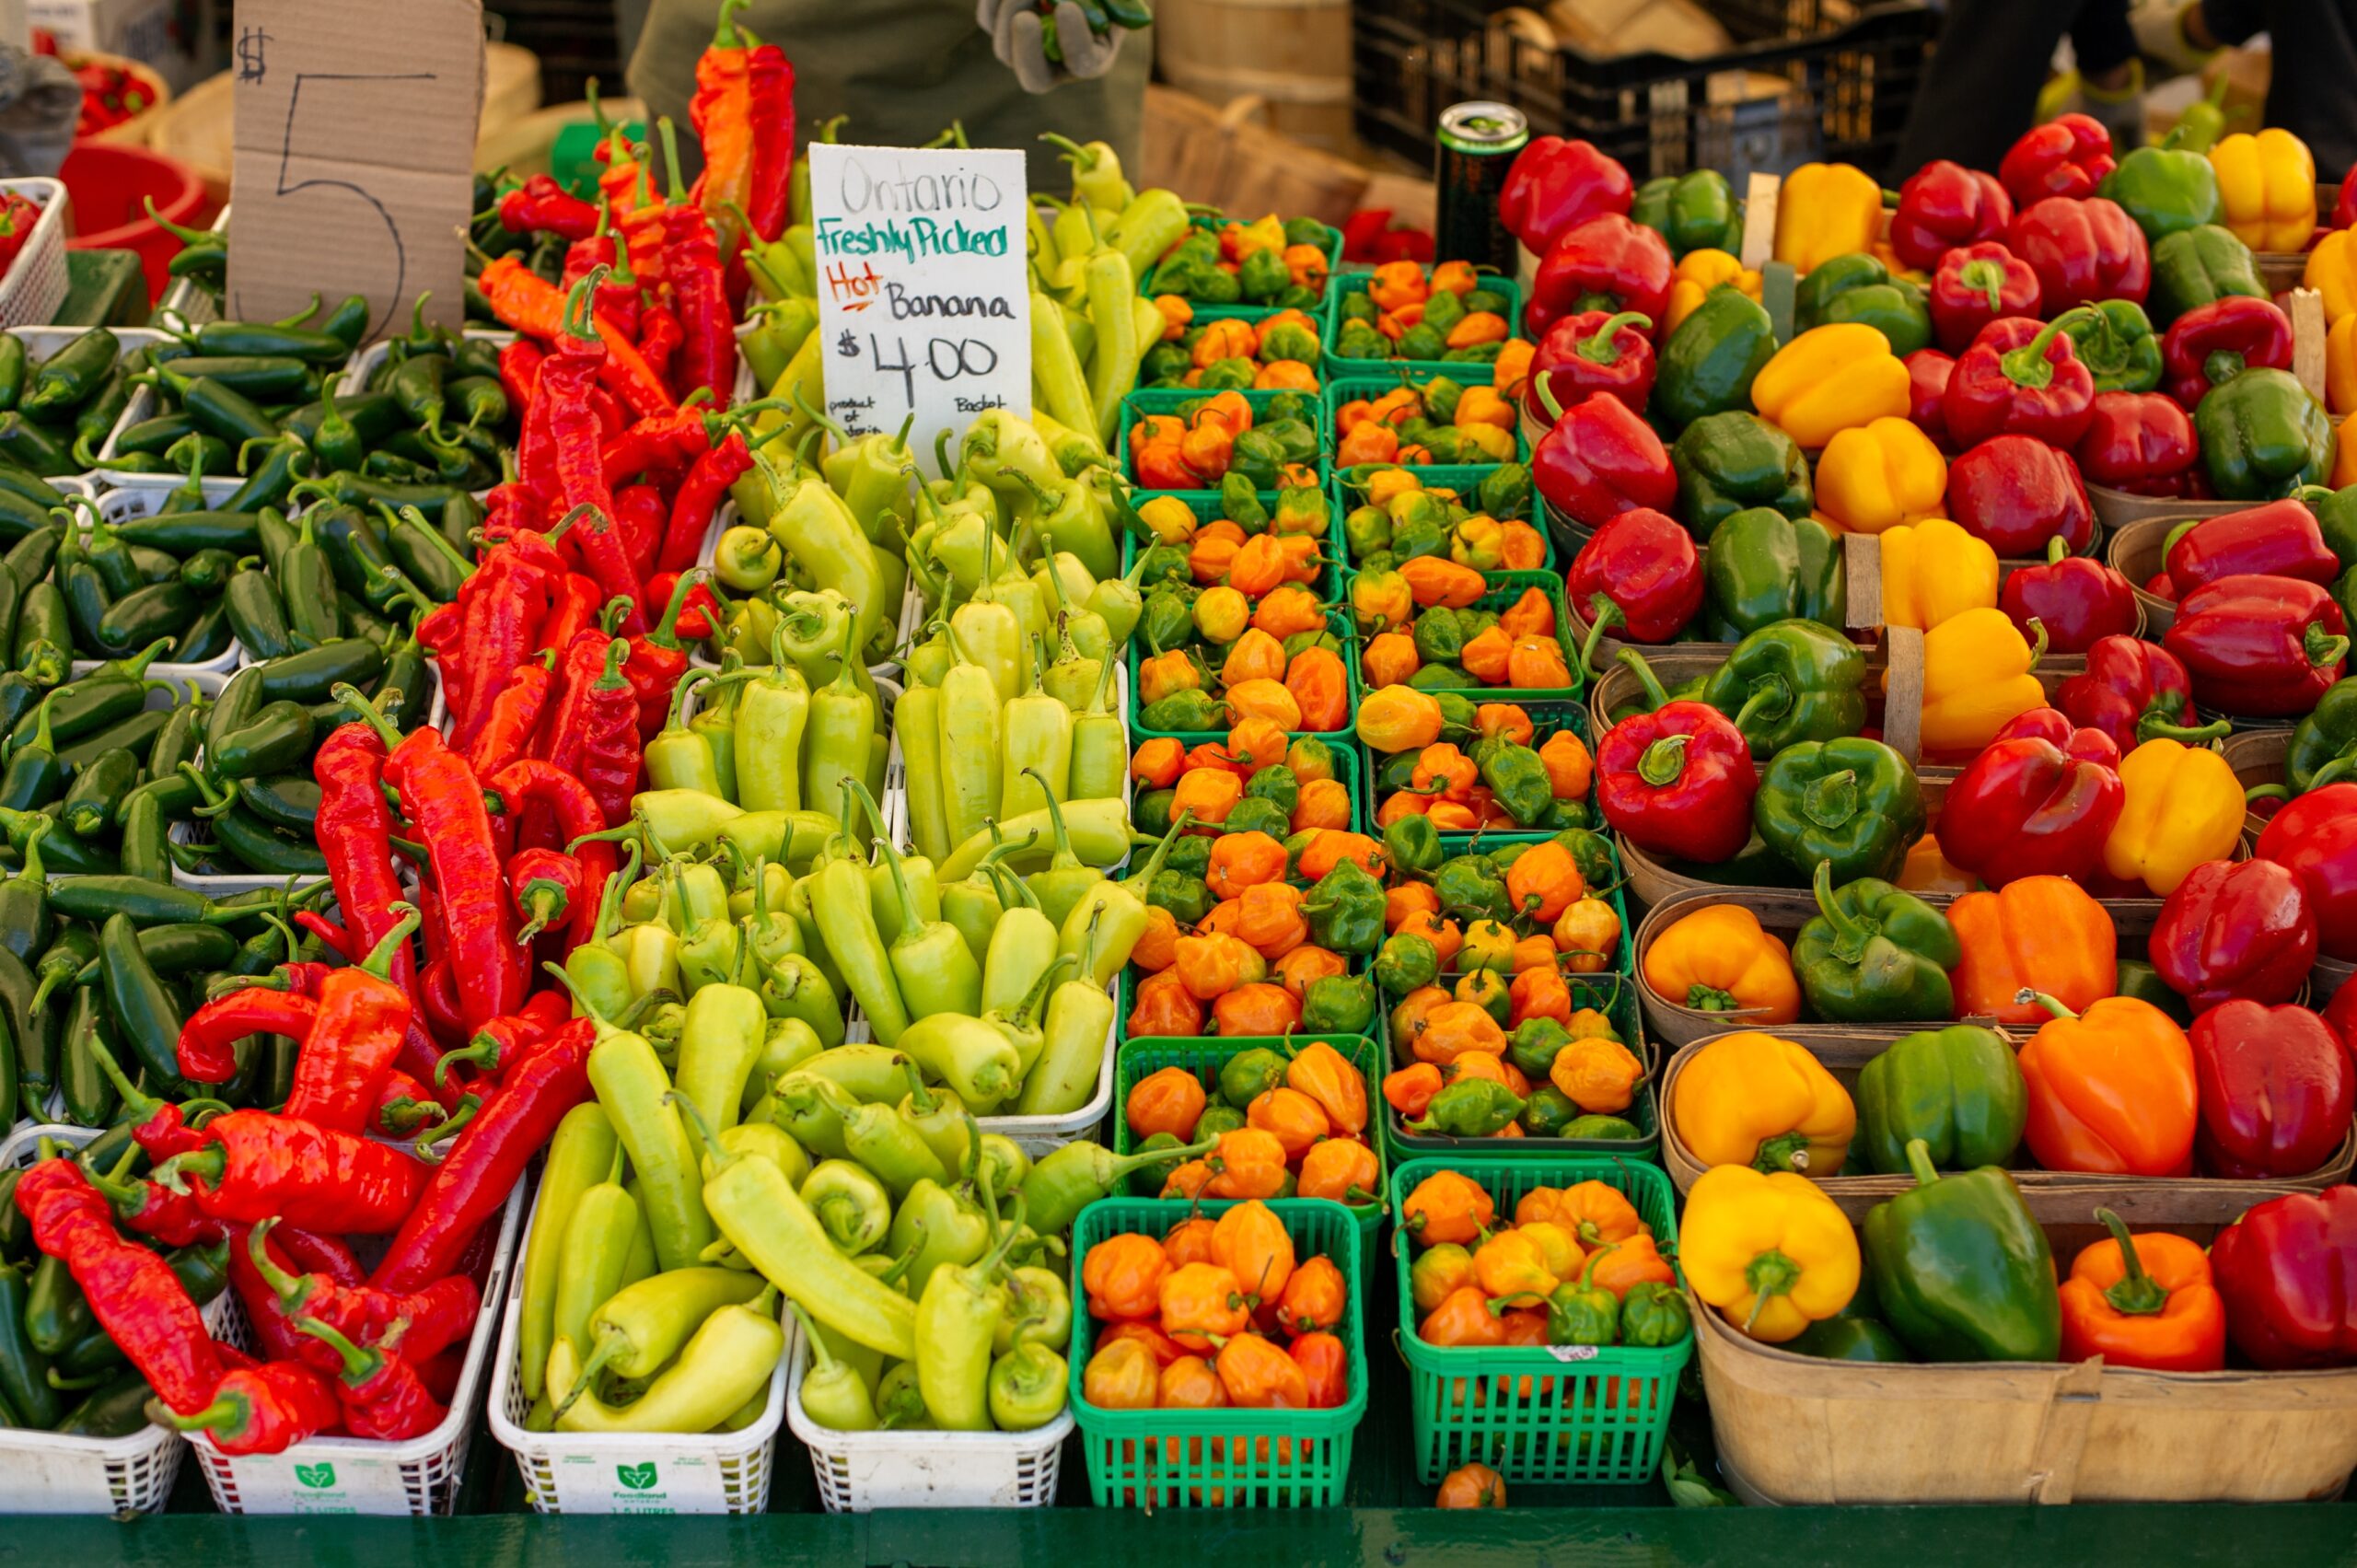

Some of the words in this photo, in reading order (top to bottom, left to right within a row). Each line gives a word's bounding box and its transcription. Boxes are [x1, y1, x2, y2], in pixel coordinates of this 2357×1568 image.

[842, 157, 1002, 214] Ontario
[826, 261, 884, 303] Hot
[885, 281, 1016, 320] Banana
[954, 394, 1008, 412] Basket
